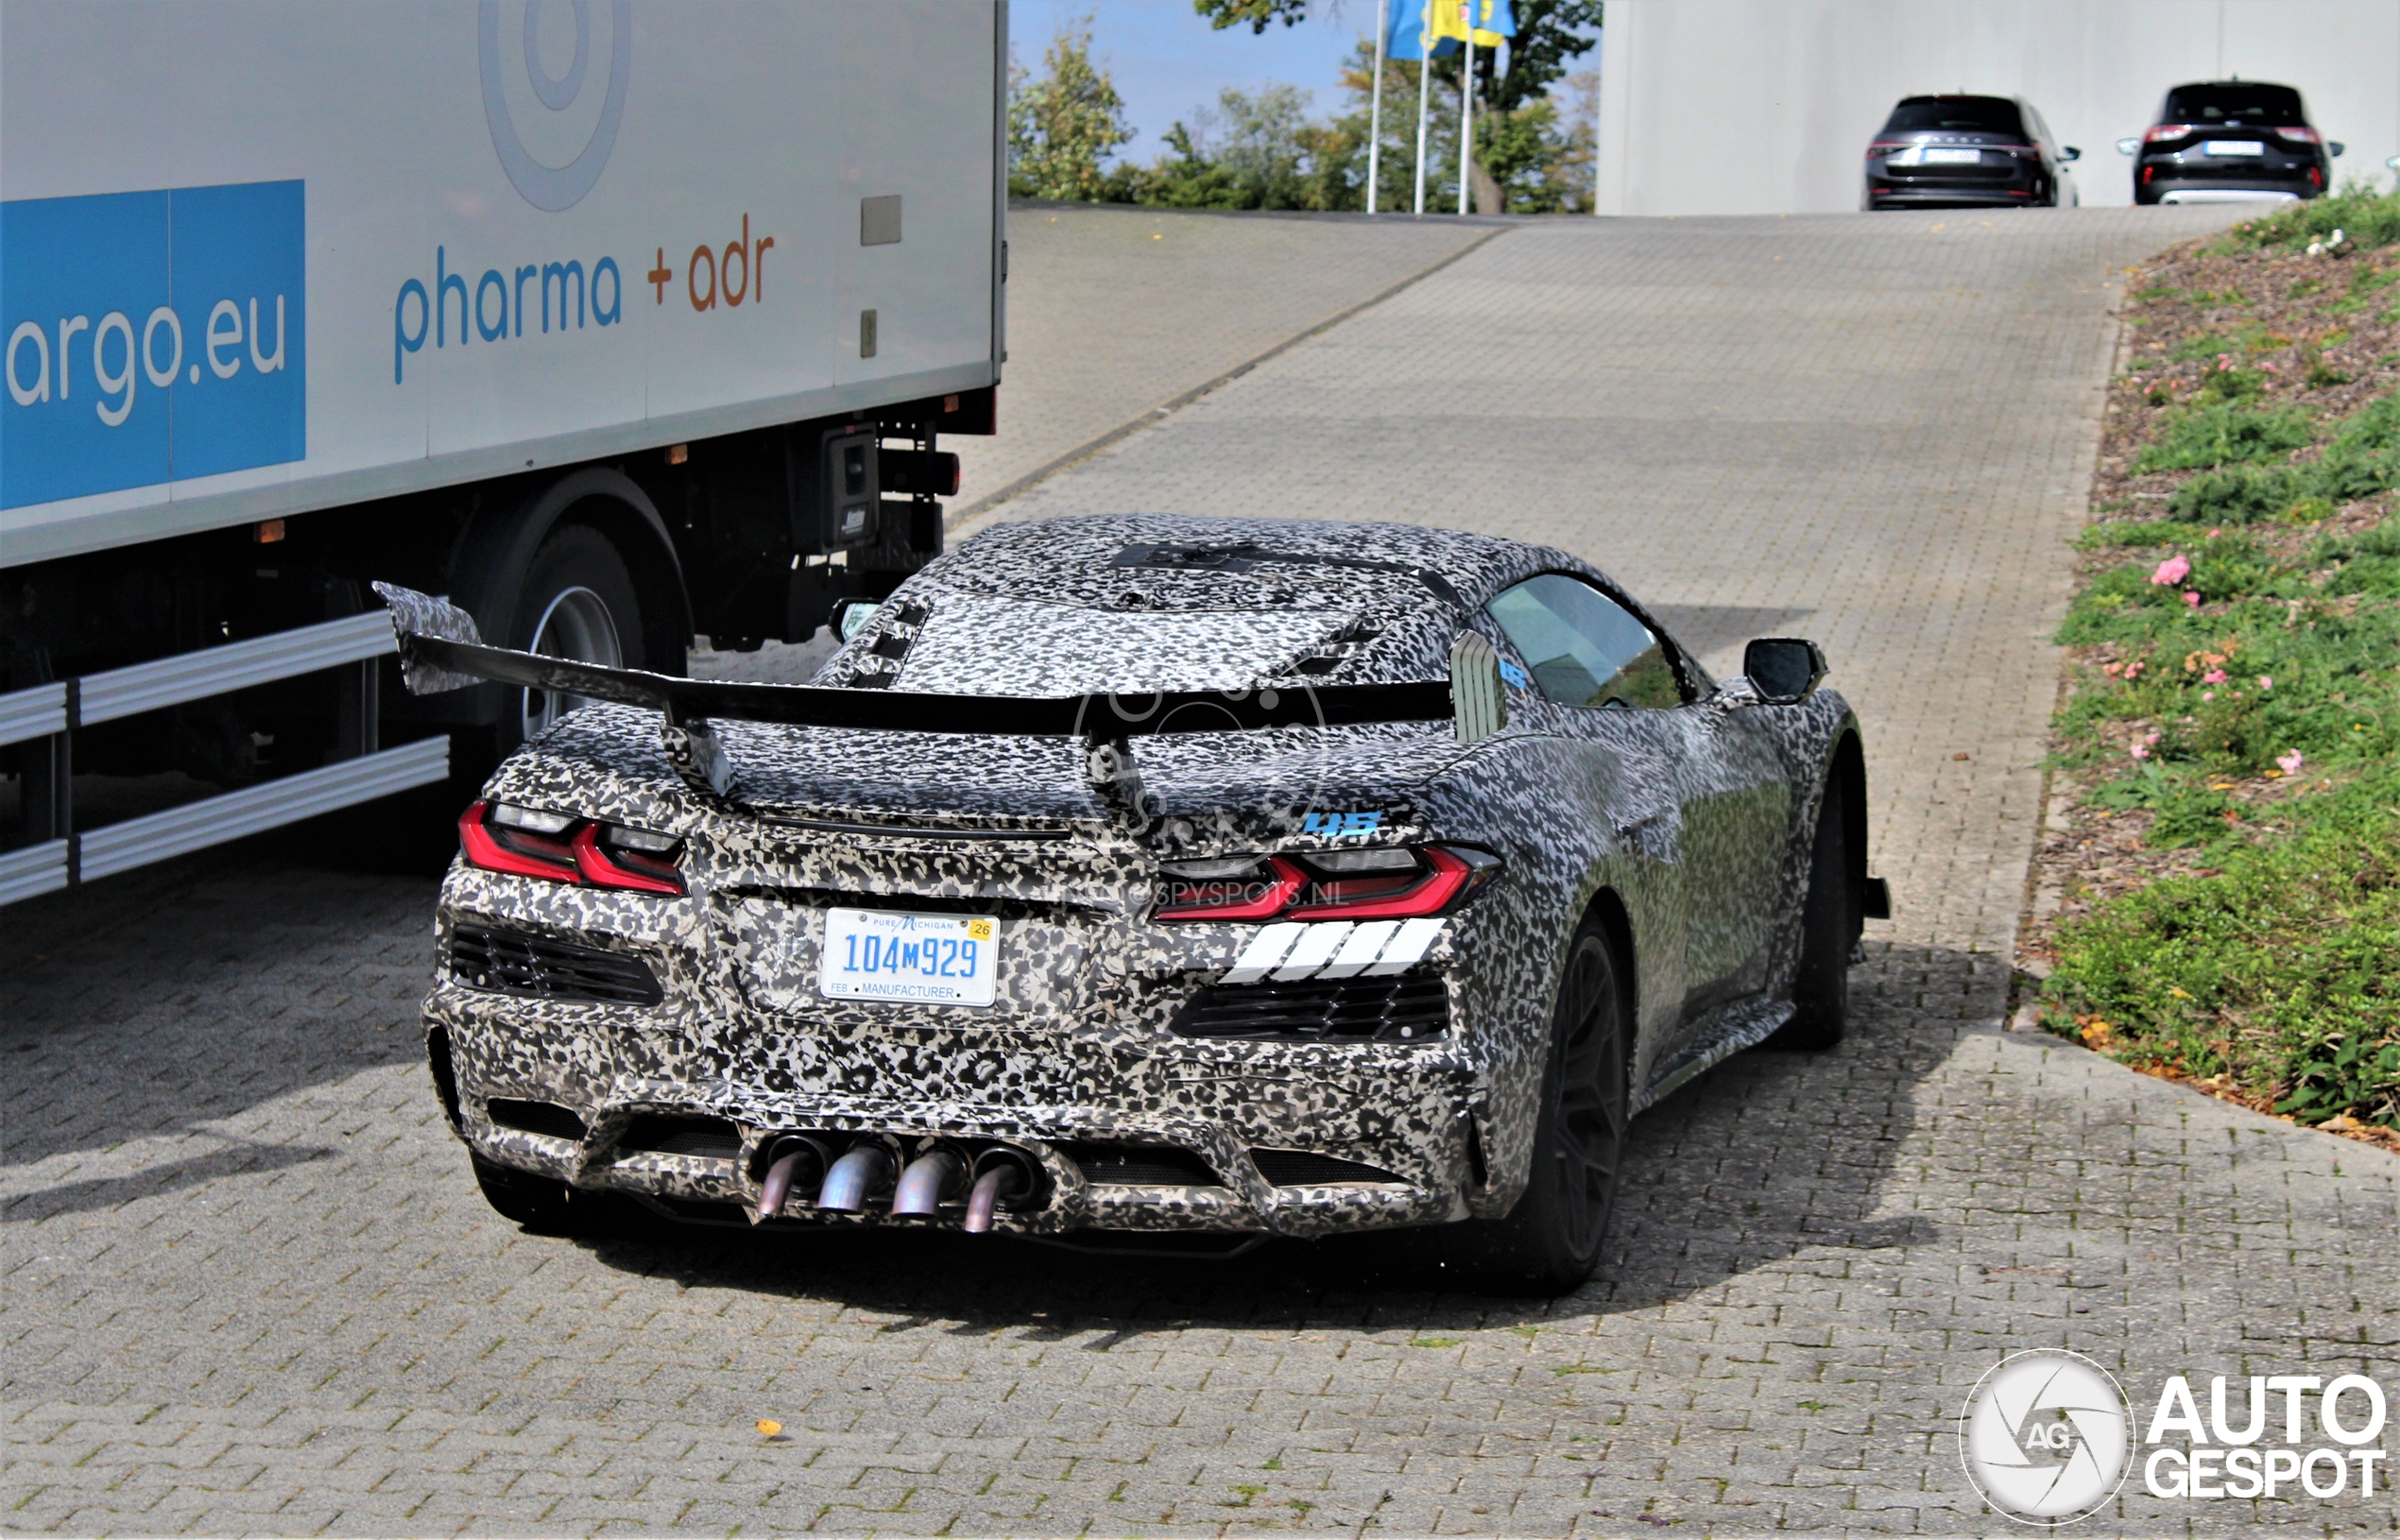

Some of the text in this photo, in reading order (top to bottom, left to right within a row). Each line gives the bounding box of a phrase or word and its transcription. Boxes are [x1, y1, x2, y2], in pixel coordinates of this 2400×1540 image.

[395, 213, 774, 385] pharma + adr
[6, 294, 284, 426] argo.eu
[873, 915, 953, 933] PURE MICHIGAN
[974, 923, 990, 935] 26
[843, 933, 977, 977] 104M929
[831, 983, 954, 999] FEB MANUFACTURER
